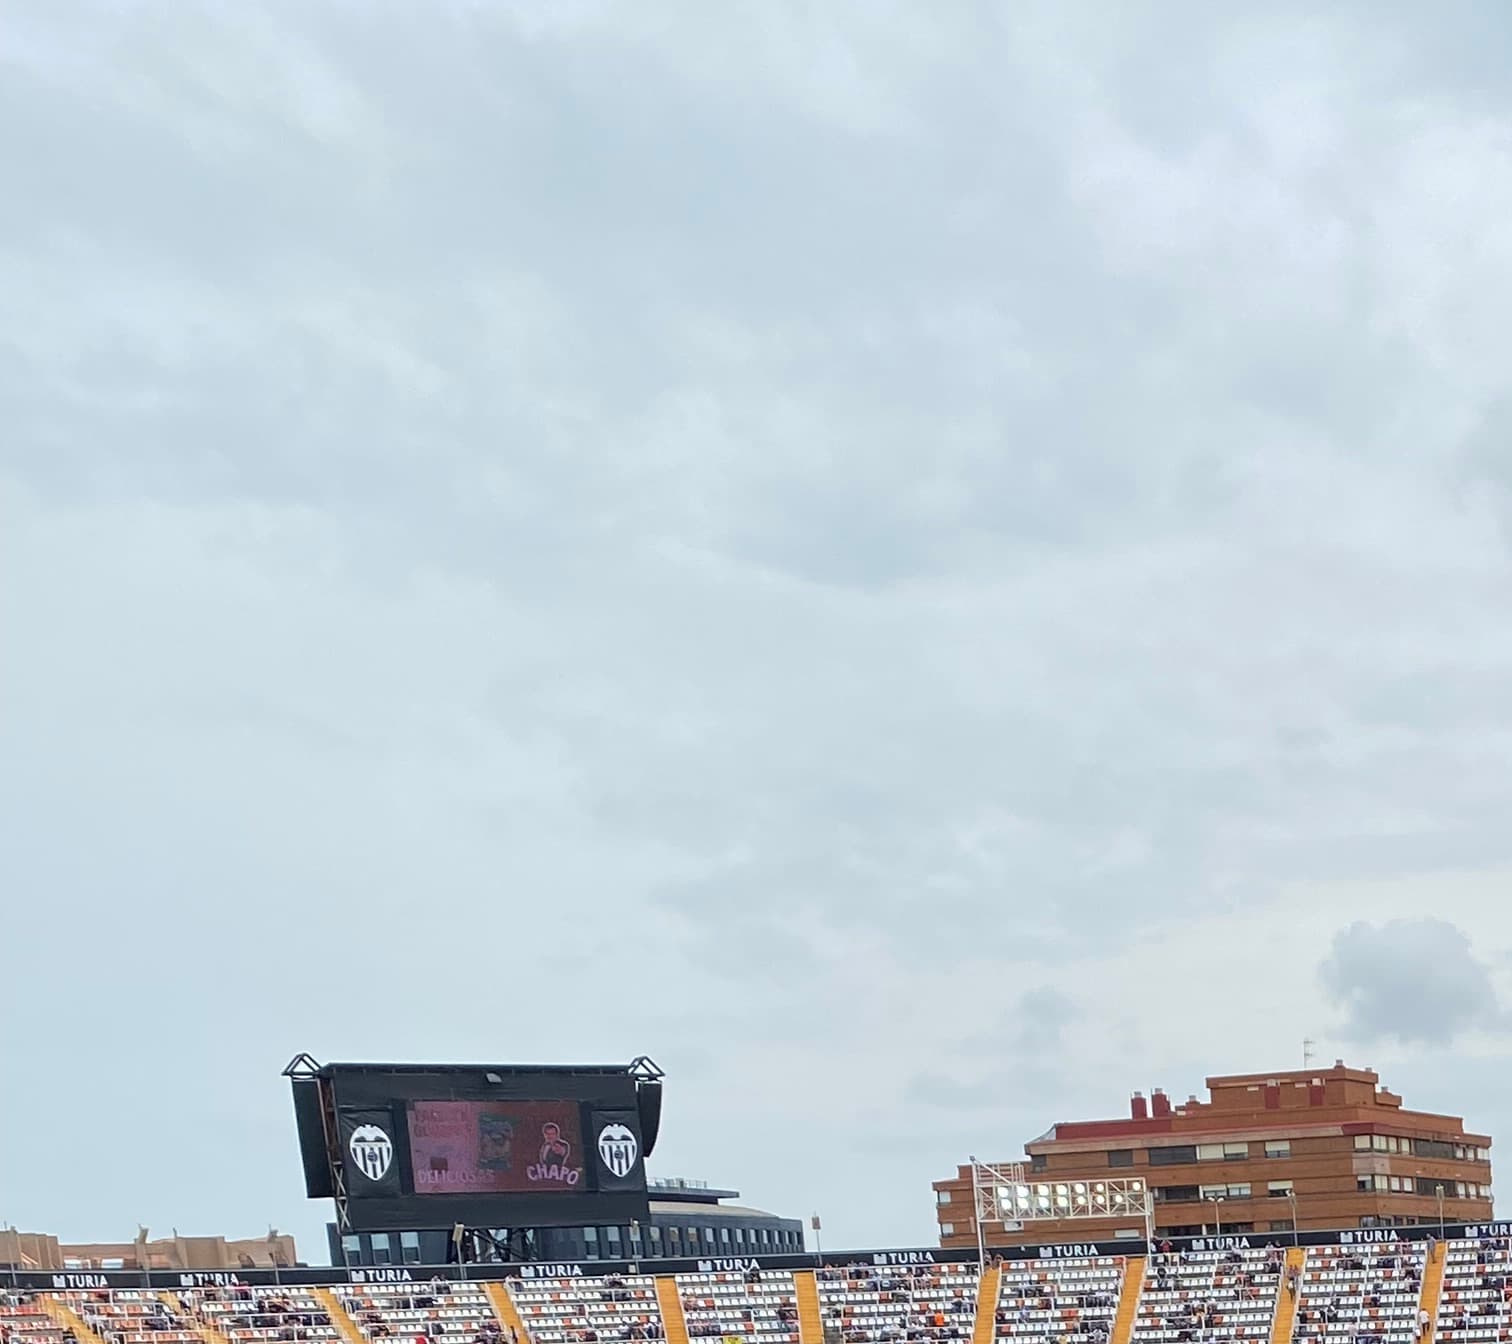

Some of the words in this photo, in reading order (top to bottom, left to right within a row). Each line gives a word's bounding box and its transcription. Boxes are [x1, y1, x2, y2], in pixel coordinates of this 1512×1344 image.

[1354, 1230, 1398, 1243] TURIA
[1206, 1237, 1250, 1250] TURIA
[1053, 1244, 1098, 1257] TURIA
[889, 1251, 935, 1264] TURIA
[537, 1264, 582, 1277] TURIA
[713, 1258, 760, 1271] TURIA
[67, 1274, 108, 1288] TURIA
[366, 1269, 412, 1282] TURIA
